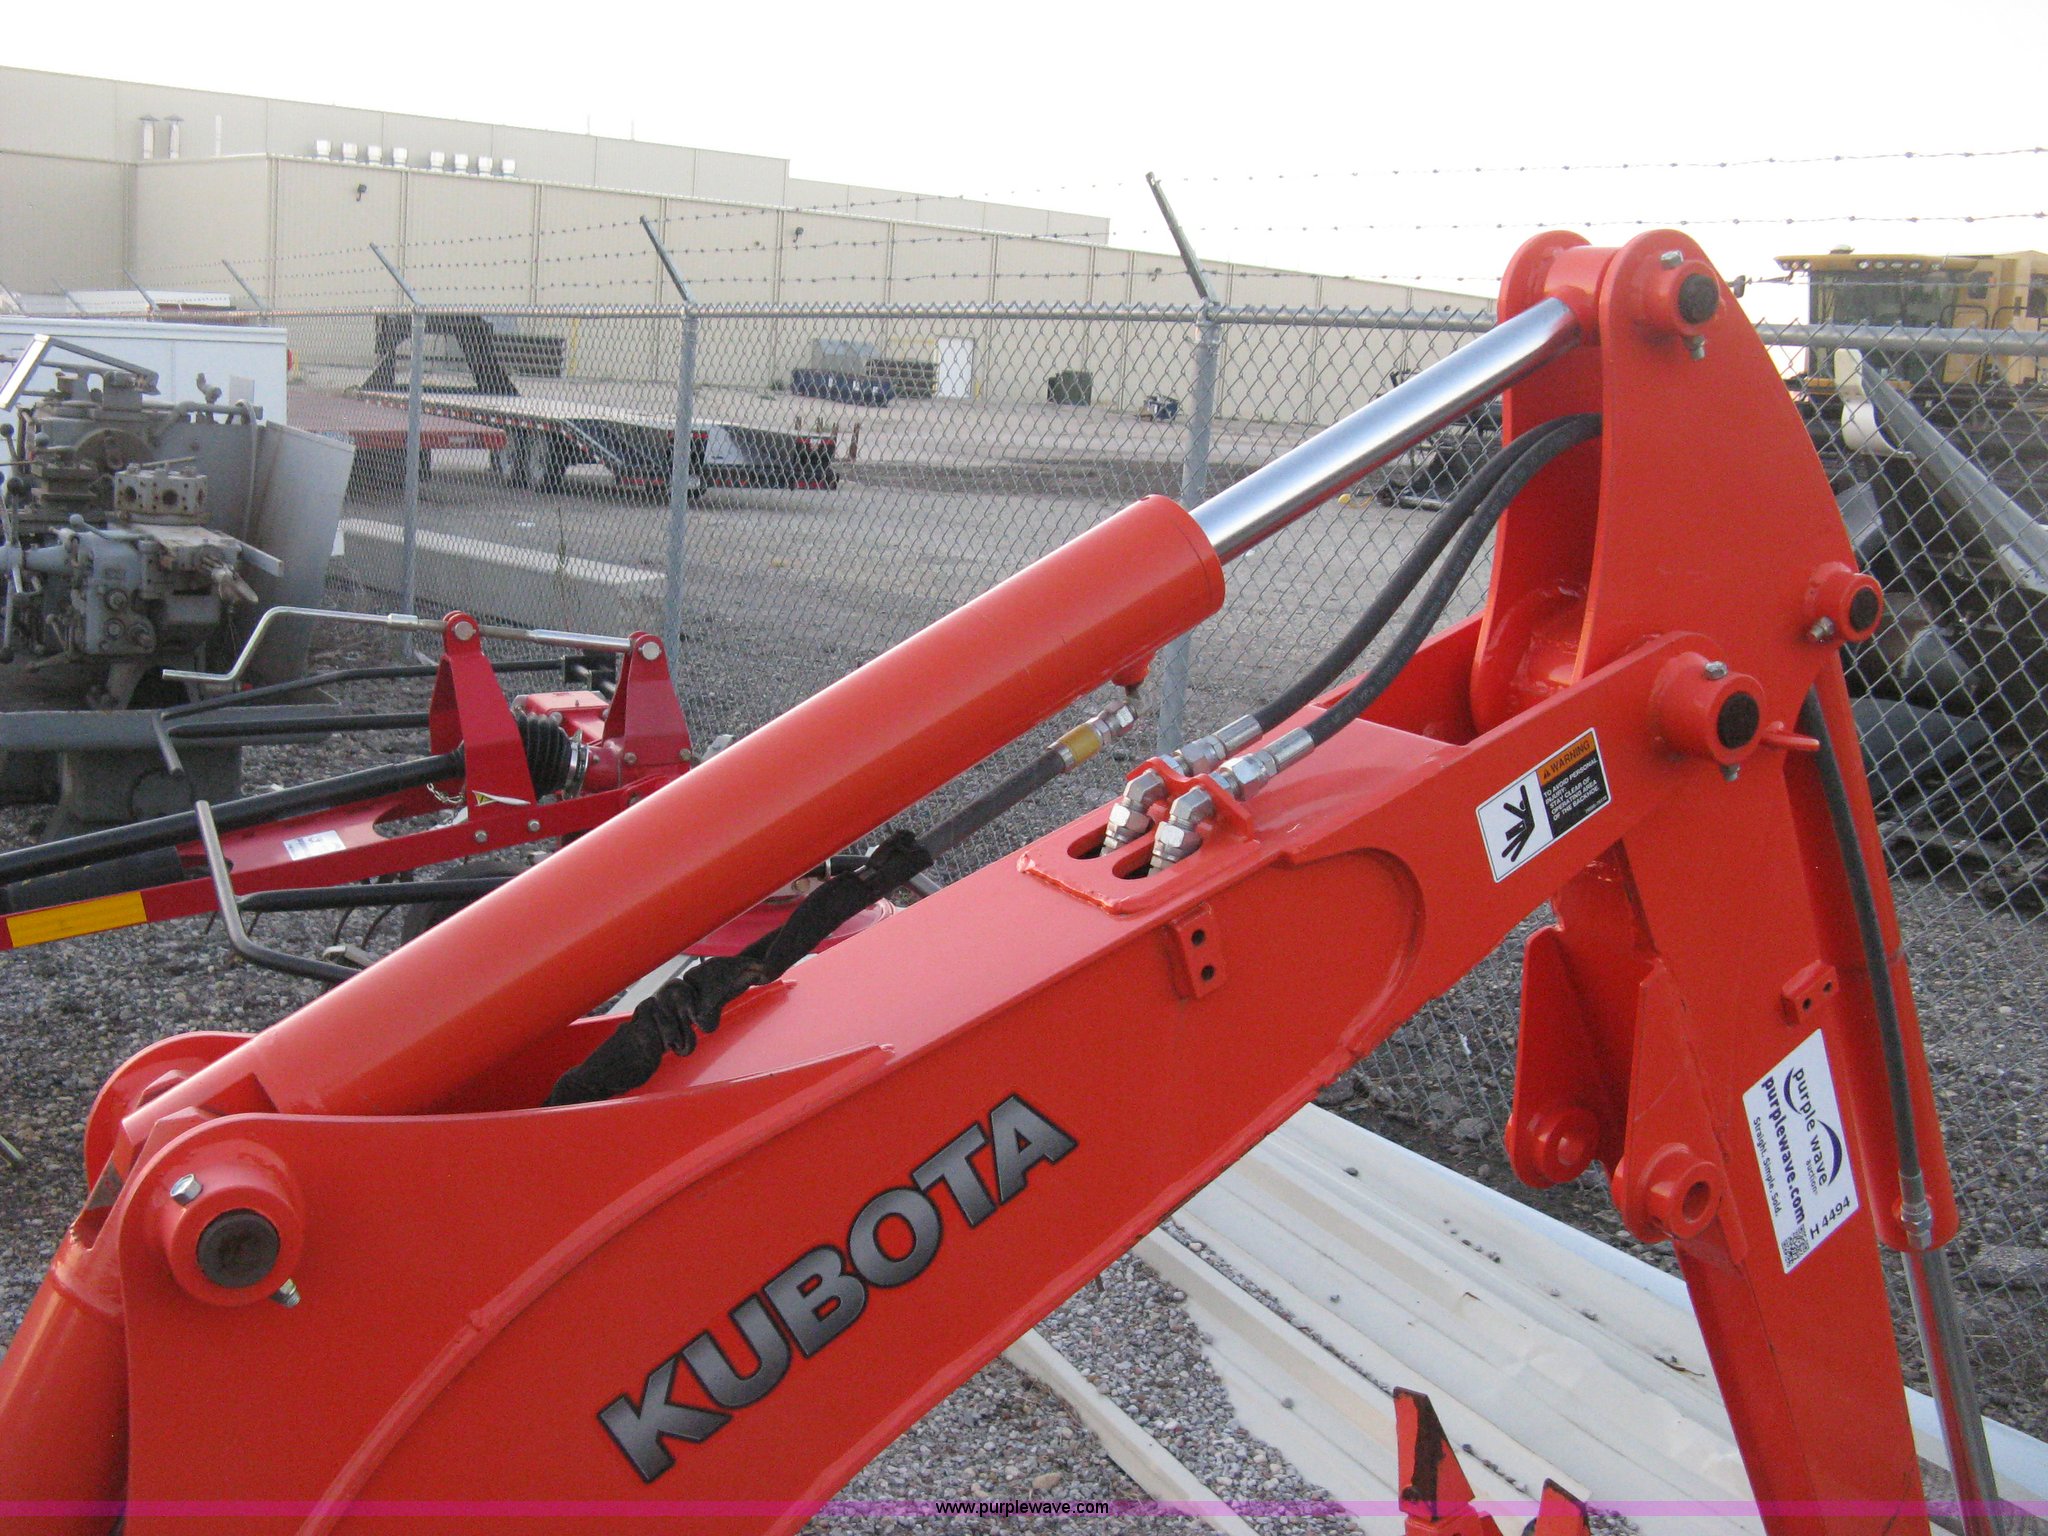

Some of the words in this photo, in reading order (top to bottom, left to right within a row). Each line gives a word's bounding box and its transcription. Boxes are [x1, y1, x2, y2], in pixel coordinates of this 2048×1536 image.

[1550, 740, 1591, 773] WARNING
[1543, 789, 1552, 798] TO
[1552, 777, 1569, 794] AVOID
[1569, 758, 1597, 780] PERSONAL
[1549, 795, 1564, 809] STAY
[1564, 782, 1583, 798] CLEAR
[1582, 776, 1591, 786] OF
[1551, 790, 1582, 815] OPERATING
[1582, 779, 1598, 793] AREA
[1553, 812, 1561, 821] OF
[1561, 804, 1573, 815] THE
[1792, 1067, 1817, 1133] purple
[1810, 1135, 1828, 1187] wave
[1753, 1116, 1766, 1158] Straight.
[1762, 1157, 1775, 1193] Simple.
[1771, 1192, 1782, 1217] Sold.
[1761, 1075, 1806, 1225] purplewave.com
[1810, 1223, 1820, 1240] H
[1821, 1195, 1851, 1228] 4494
[597, 1093, 1079, 1485] KUBOTA
